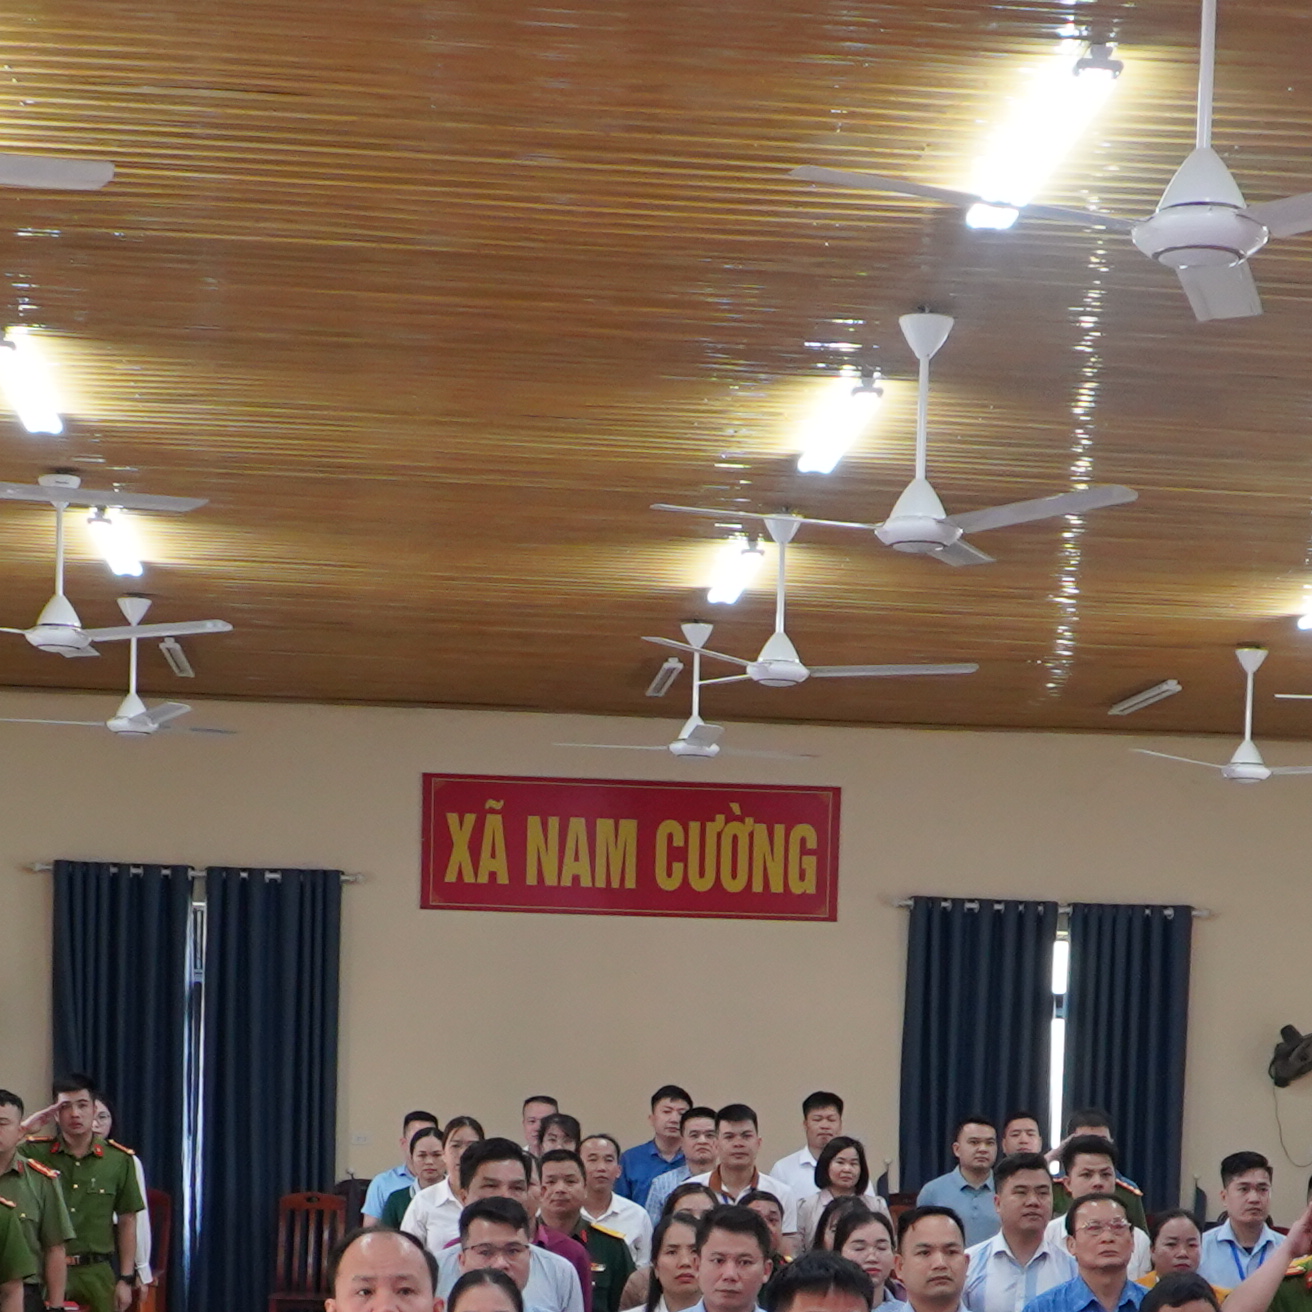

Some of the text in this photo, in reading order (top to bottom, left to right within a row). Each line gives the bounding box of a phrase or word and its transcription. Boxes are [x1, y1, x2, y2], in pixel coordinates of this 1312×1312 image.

[444, 799, 818, 894] XÃ NAM CƯỜNG
